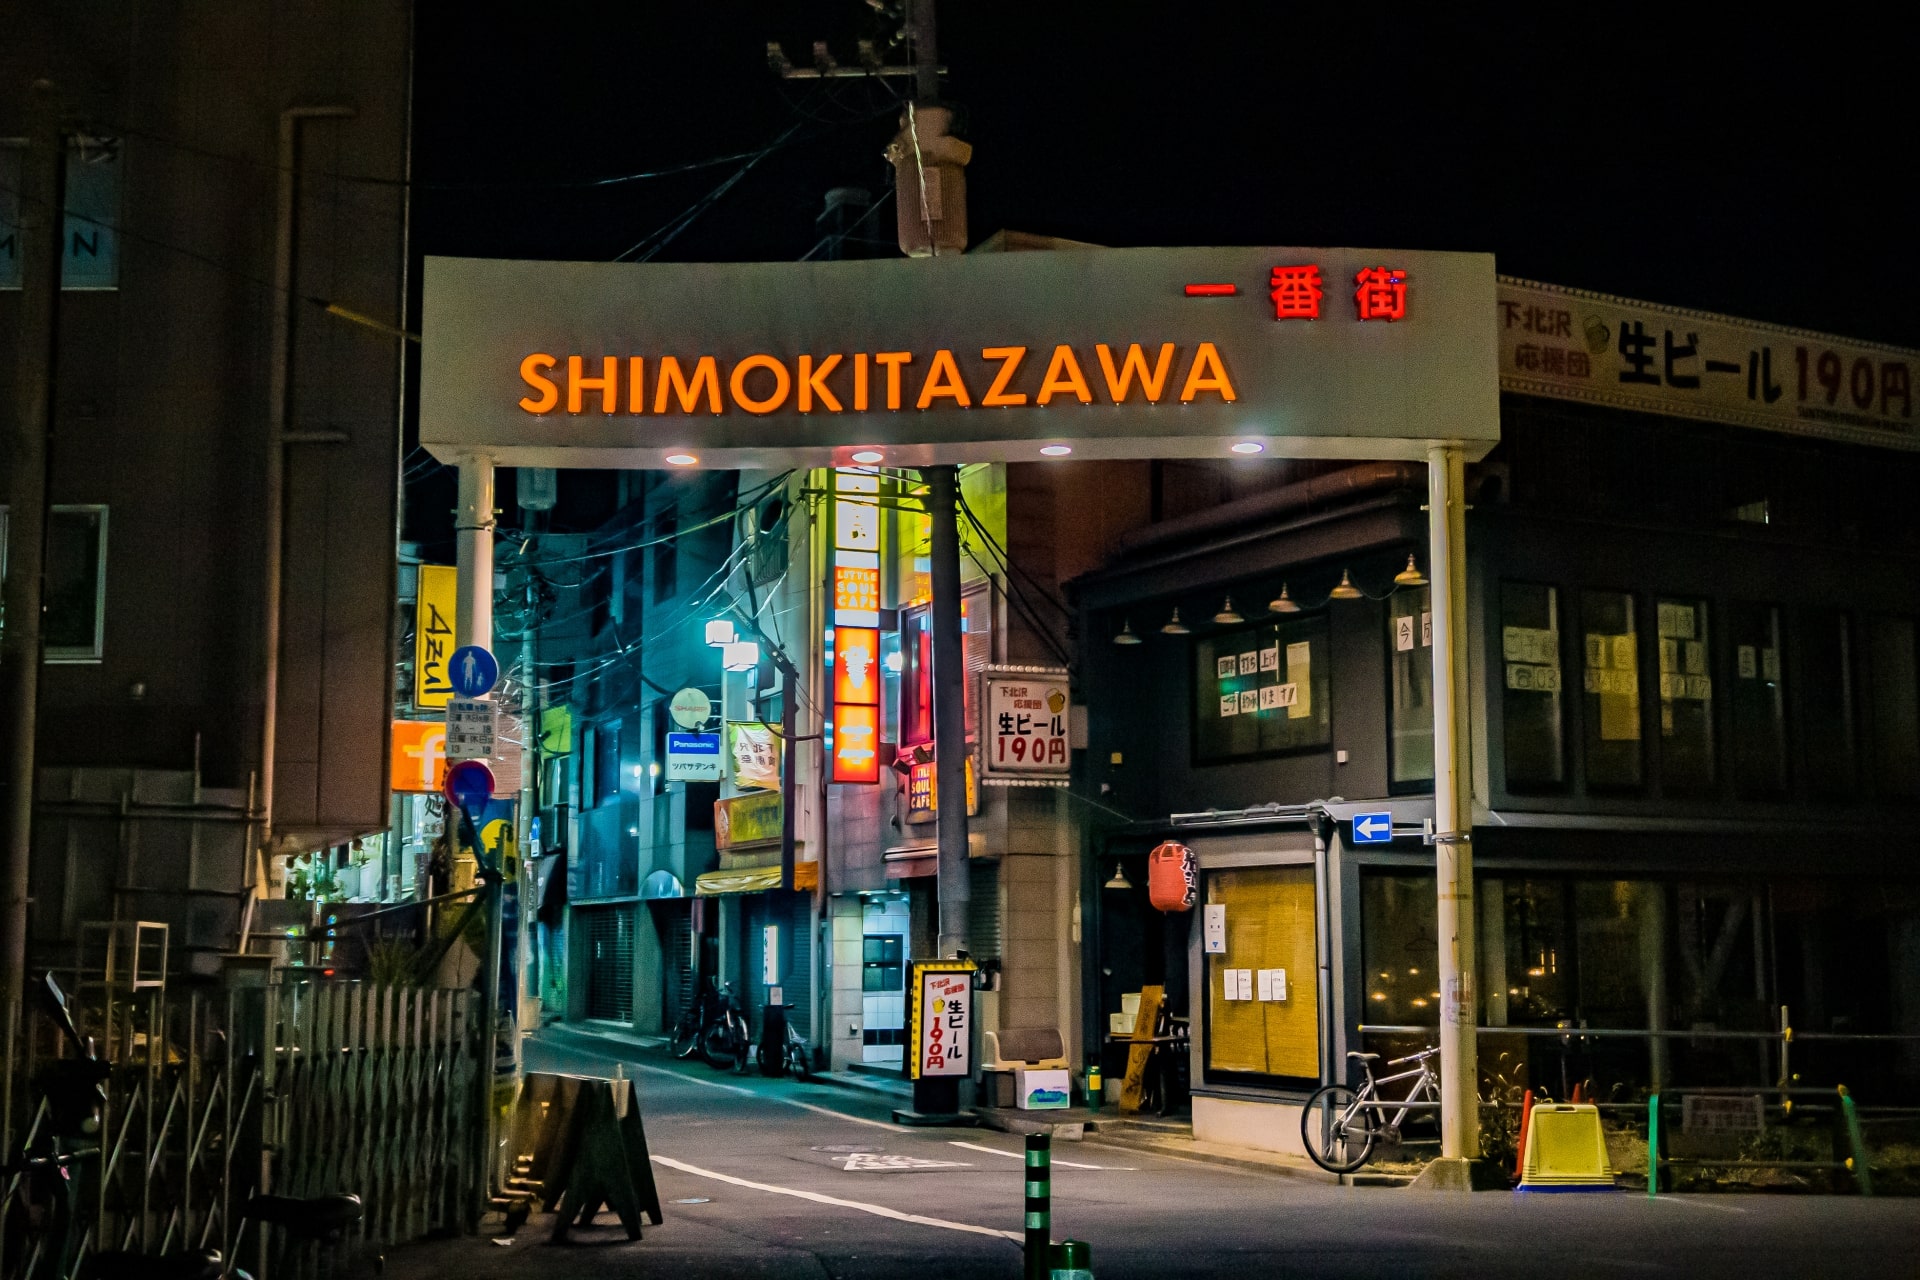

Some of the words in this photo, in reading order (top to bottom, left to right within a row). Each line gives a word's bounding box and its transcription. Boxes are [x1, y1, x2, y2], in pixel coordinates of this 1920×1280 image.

[1184, 264, 1408, 321] 一番街
[1500, 301, 1572, 339] 下北沢
[1515, 343, 1591, 379] 応援団
[1619, 321, 1783, 404] 生ビール
[1796, 345, 1912, 418] 190円
[518, 341, 1237, 414] SHIMOKITAZAWA
[837, 570, 877, 581] LITTLE
[837, 582, 877, 595] SOUL
[999, 686, 1028, 697] 下北沢
[674, 704, 708, 712] SHARP
[998, 711, 1066, 737] 生ビール
[673, 740, 715, 749] Panasonic
[998, 736, 1066, 764] 190円
[672, 762, 717, 772] ツバサデンキ
[911, 779, 930, 794] SOUL
[926, 1016, 945, 1069] 190円
[947, 1000, 965, 1059] 生ビール
